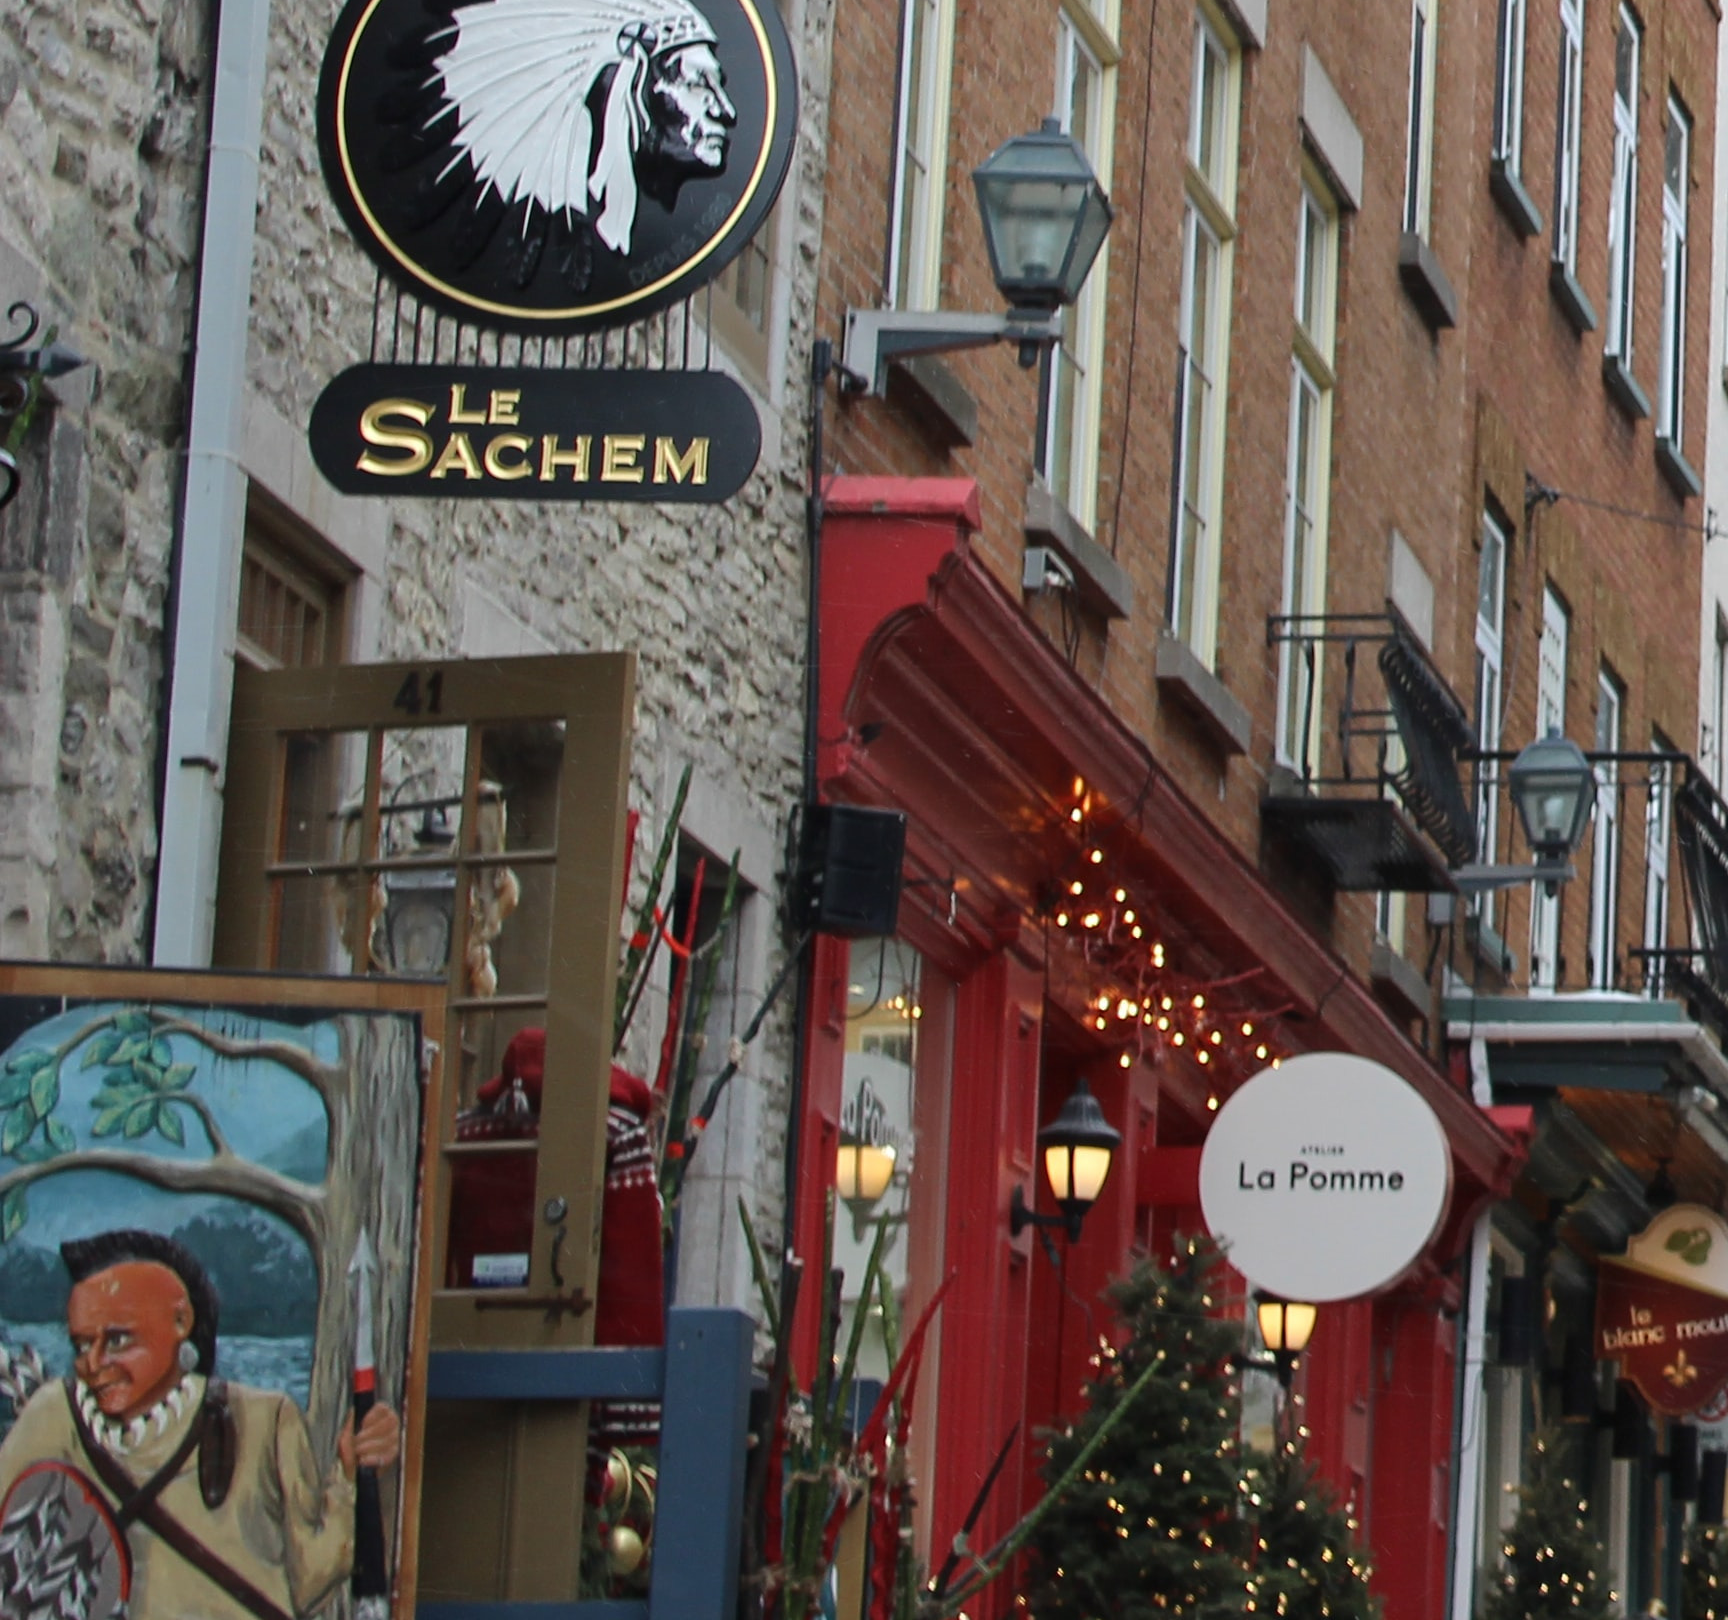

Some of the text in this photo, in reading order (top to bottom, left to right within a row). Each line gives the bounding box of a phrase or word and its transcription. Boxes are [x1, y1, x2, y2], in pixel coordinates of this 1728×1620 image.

[448, 383, 521, 426] LE
[357, 398, 710, 485] SACHEM
[393, 668, 442, 715] 41
[1301, 1145, 1344, 1156] ATELIER
[1238, 1161, 1404, 1191] La Pomme
[1630, 1303, 1652, 1327] le
[1602, 1325, 1665, 1350] blanc
